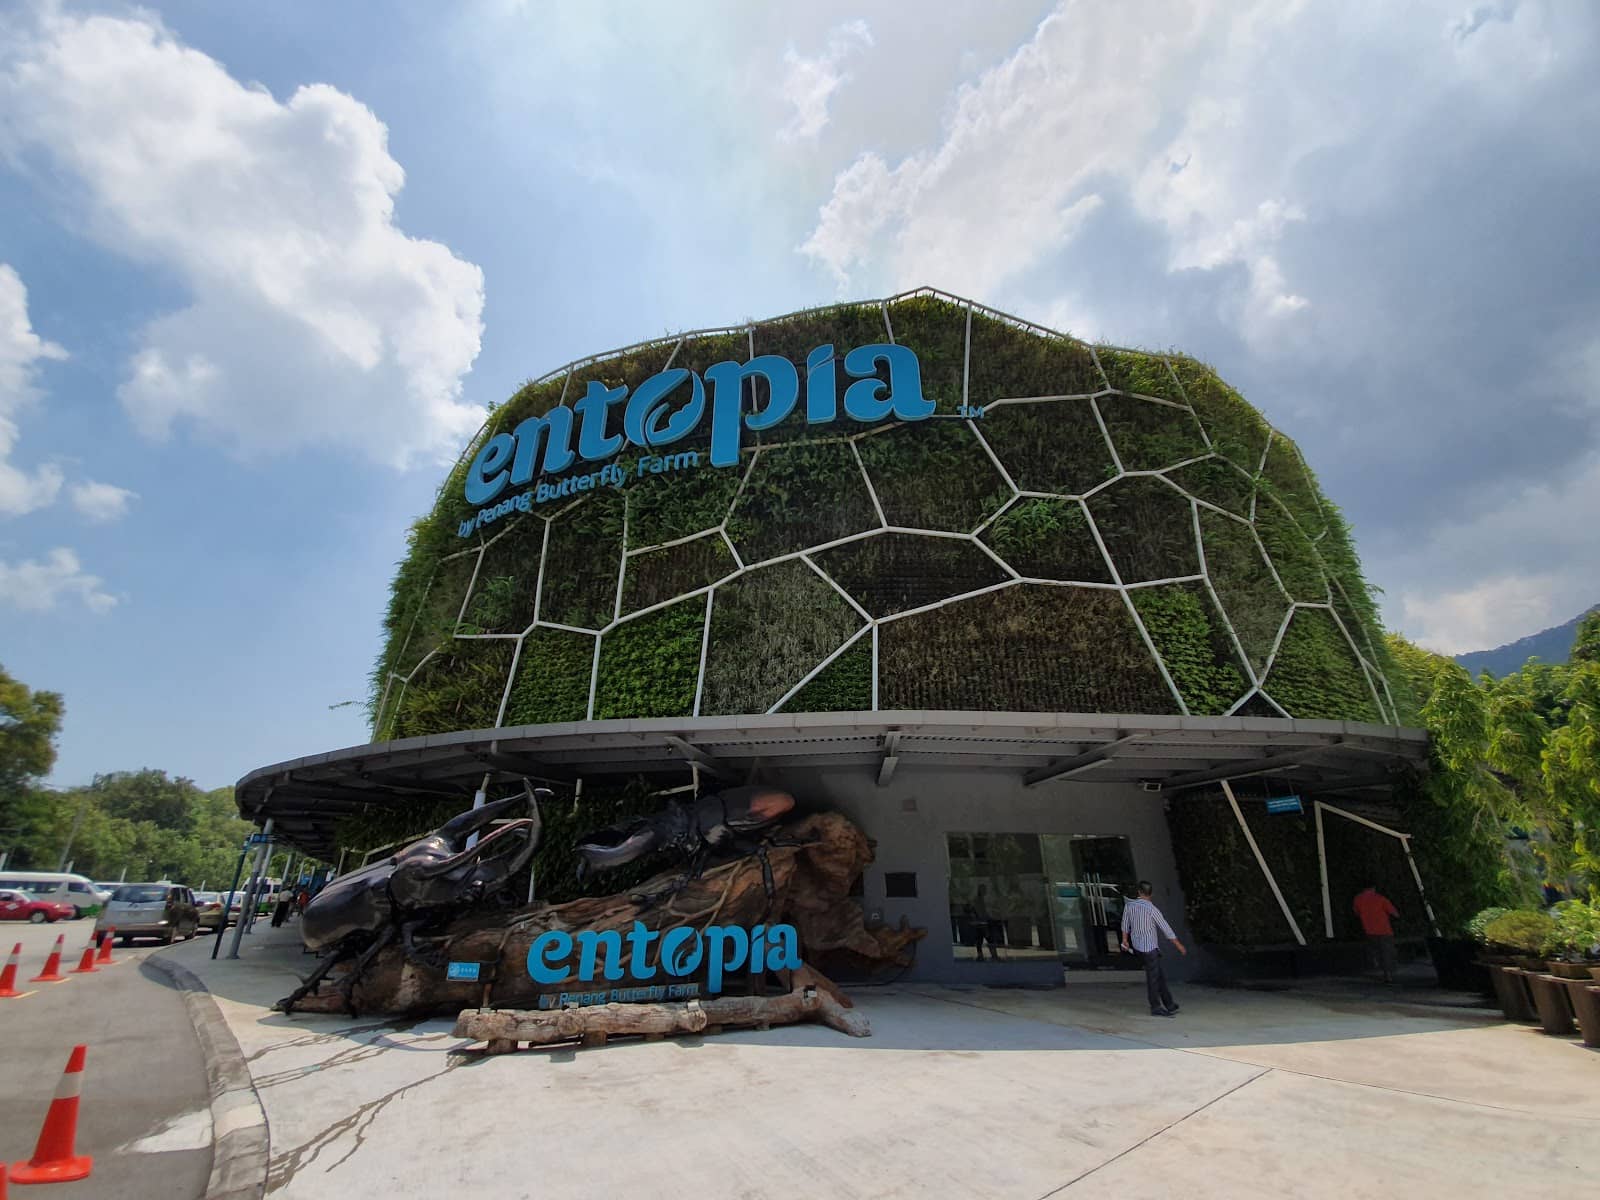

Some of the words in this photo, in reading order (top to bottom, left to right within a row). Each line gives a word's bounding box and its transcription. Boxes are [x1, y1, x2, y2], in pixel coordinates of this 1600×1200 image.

[464, 343, 936, 505] entopia
[457, 516, 477, 538] by
[475, 491, 535, 529] Penang
[536, 463, 627, 503] Butterfly
[637, 450, 699, 478] Farm
[526, 920, 803, 993] entopia
[668, 983, 699, 997] Farm
